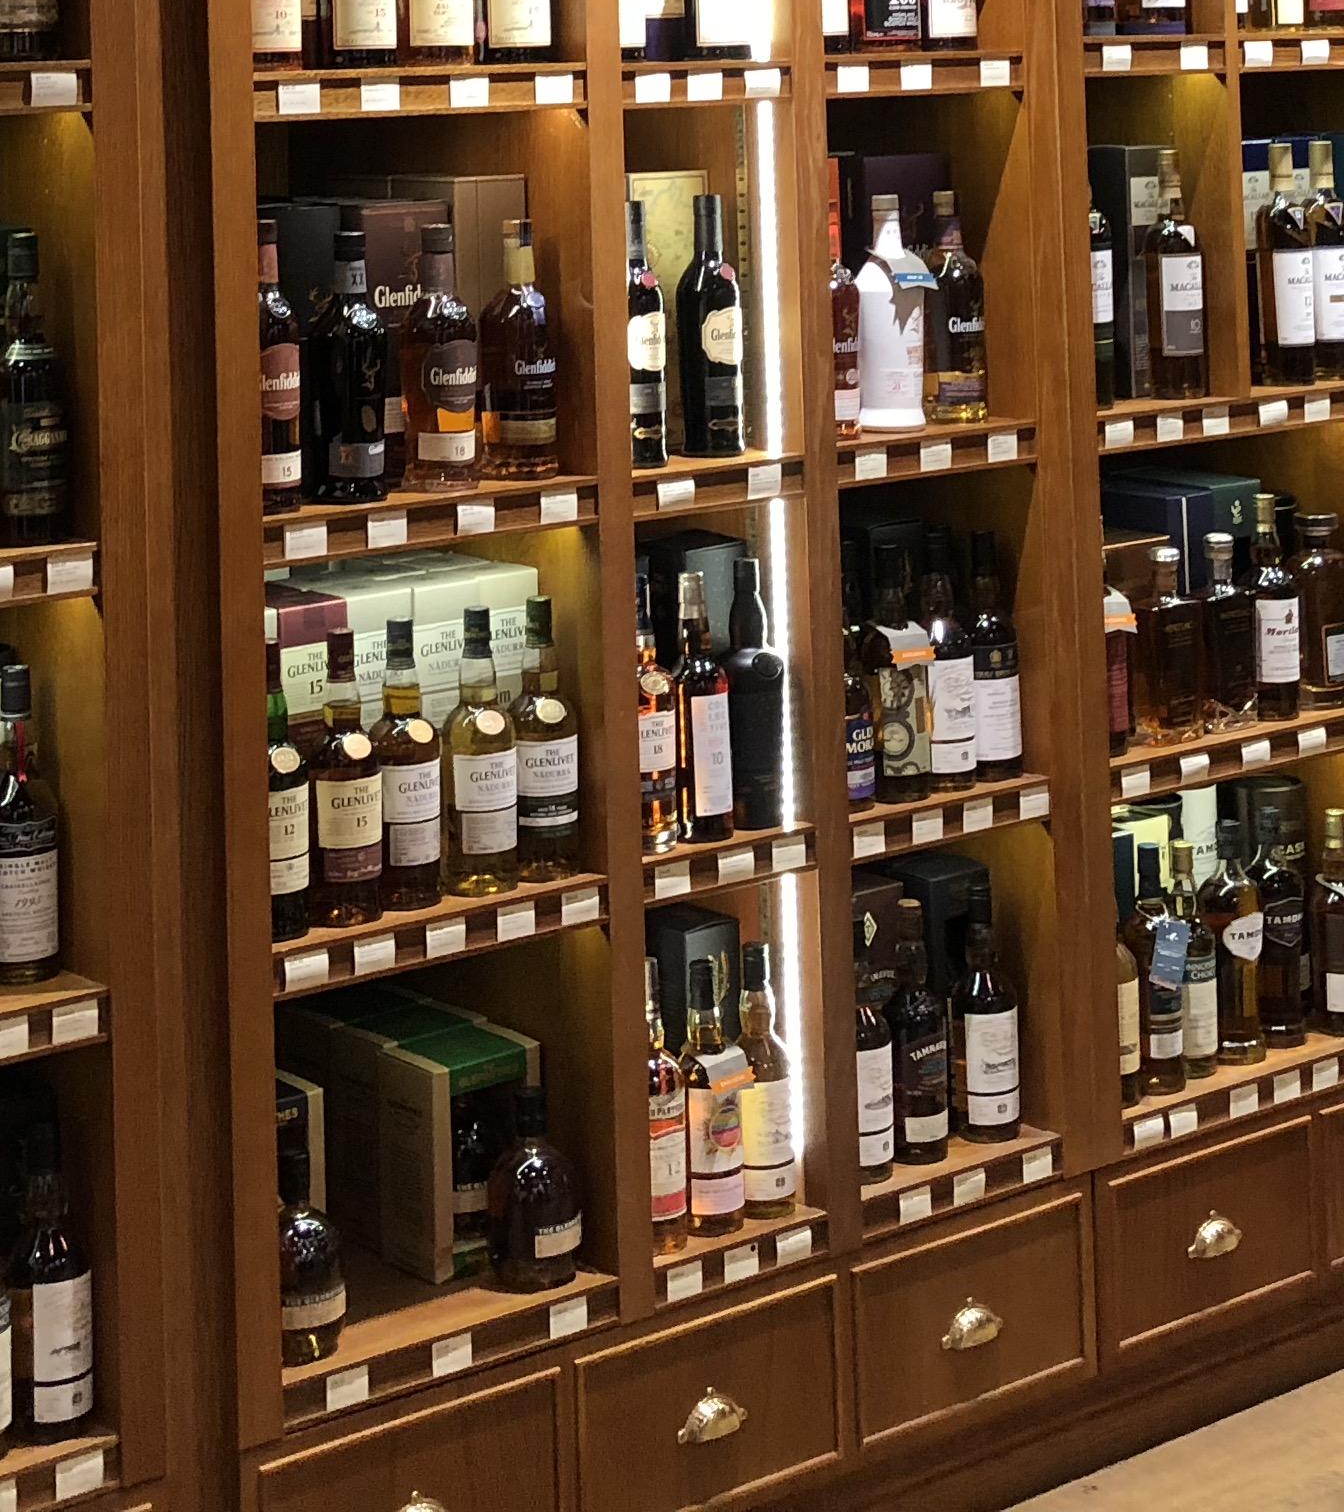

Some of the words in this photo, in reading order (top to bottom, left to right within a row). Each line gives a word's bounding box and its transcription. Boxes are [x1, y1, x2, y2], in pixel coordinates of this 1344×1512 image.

[308, 679, 324, 696] 15
[355, 816, 368, 829] 15
[283, 823, 296, 837] 12
